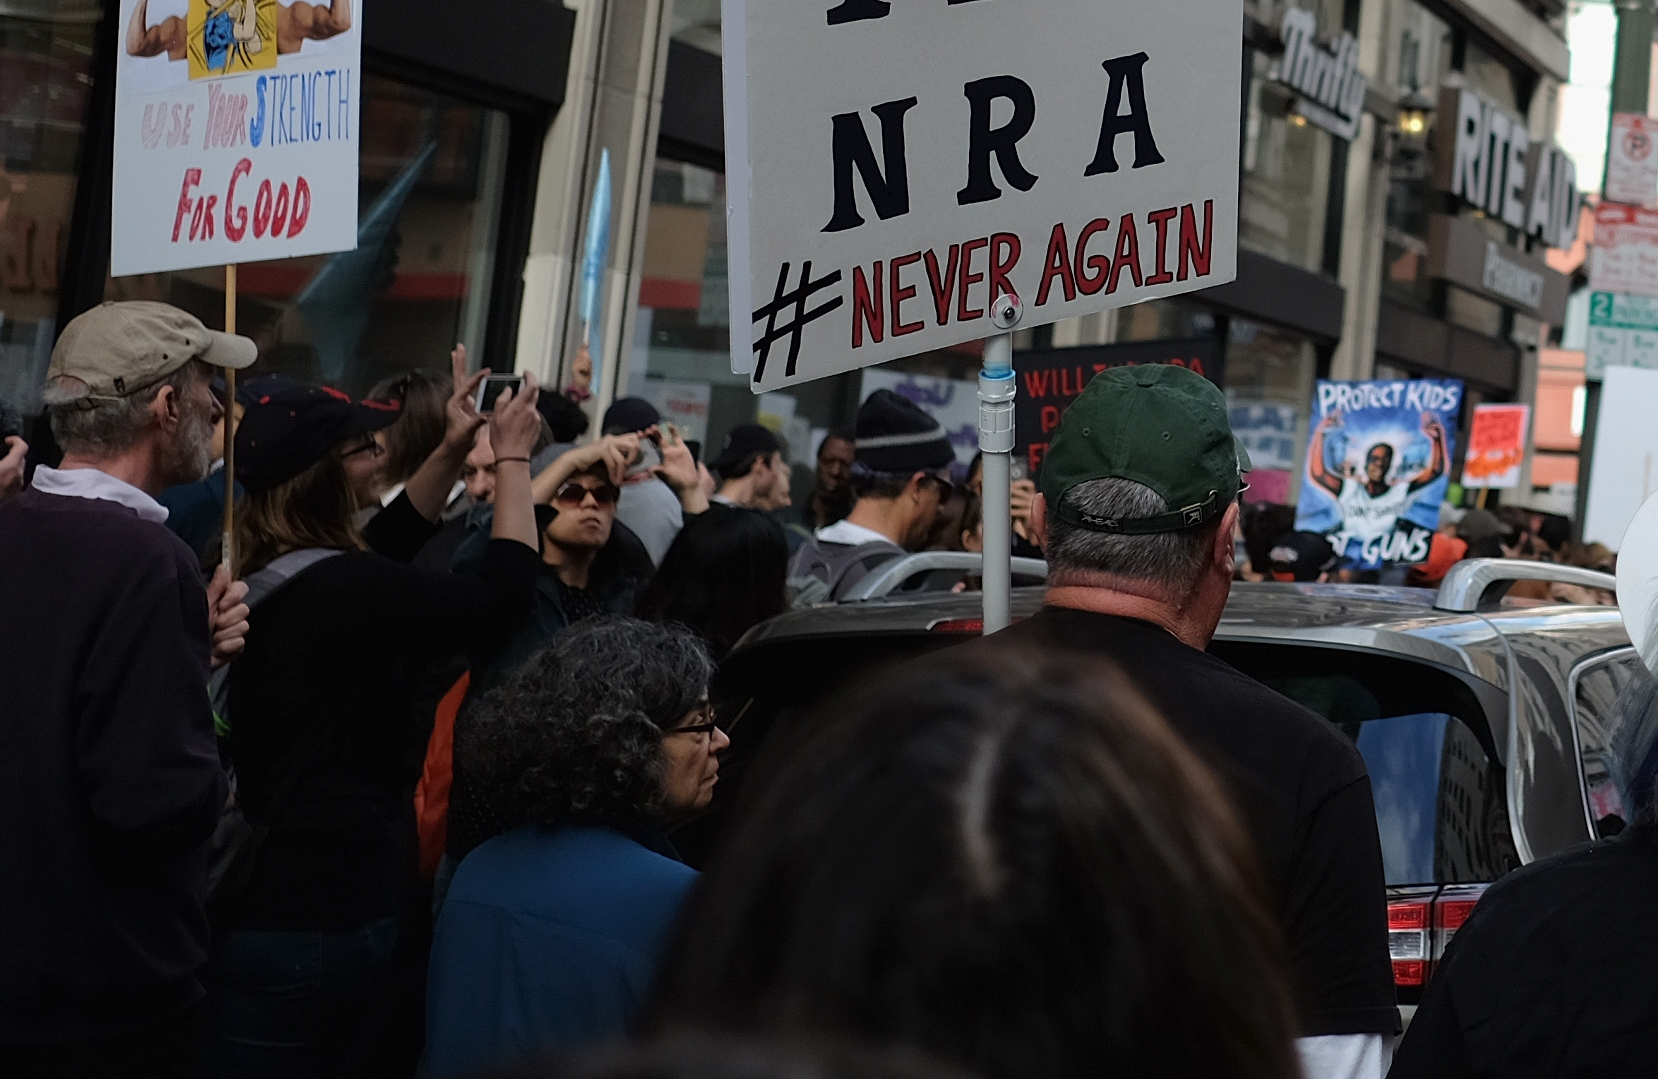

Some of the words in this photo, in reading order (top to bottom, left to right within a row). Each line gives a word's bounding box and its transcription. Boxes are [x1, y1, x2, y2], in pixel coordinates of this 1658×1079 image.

[141, 101, 195, 150] USE
[203, 82, 248, 151] YOUR
[250, 69, 350, 149] STRENGTH
[1270, 8, 1366, 140] Thrifty
[820, 51, 1166, 233] NRA
[1452, 87, 1530, 227] RITE
[1527, 144, 1580, 250] AID
[171, 167, 218, 243] FOR
[224, 157, 311, 243] GOOD
[1034, 199, 1214, 307] AGAIN
[1025, 365, 1085, 399] WILL
[1404, 378, 1459, 413] KIDS
[1361, 528, 1432, 564] GUNS
